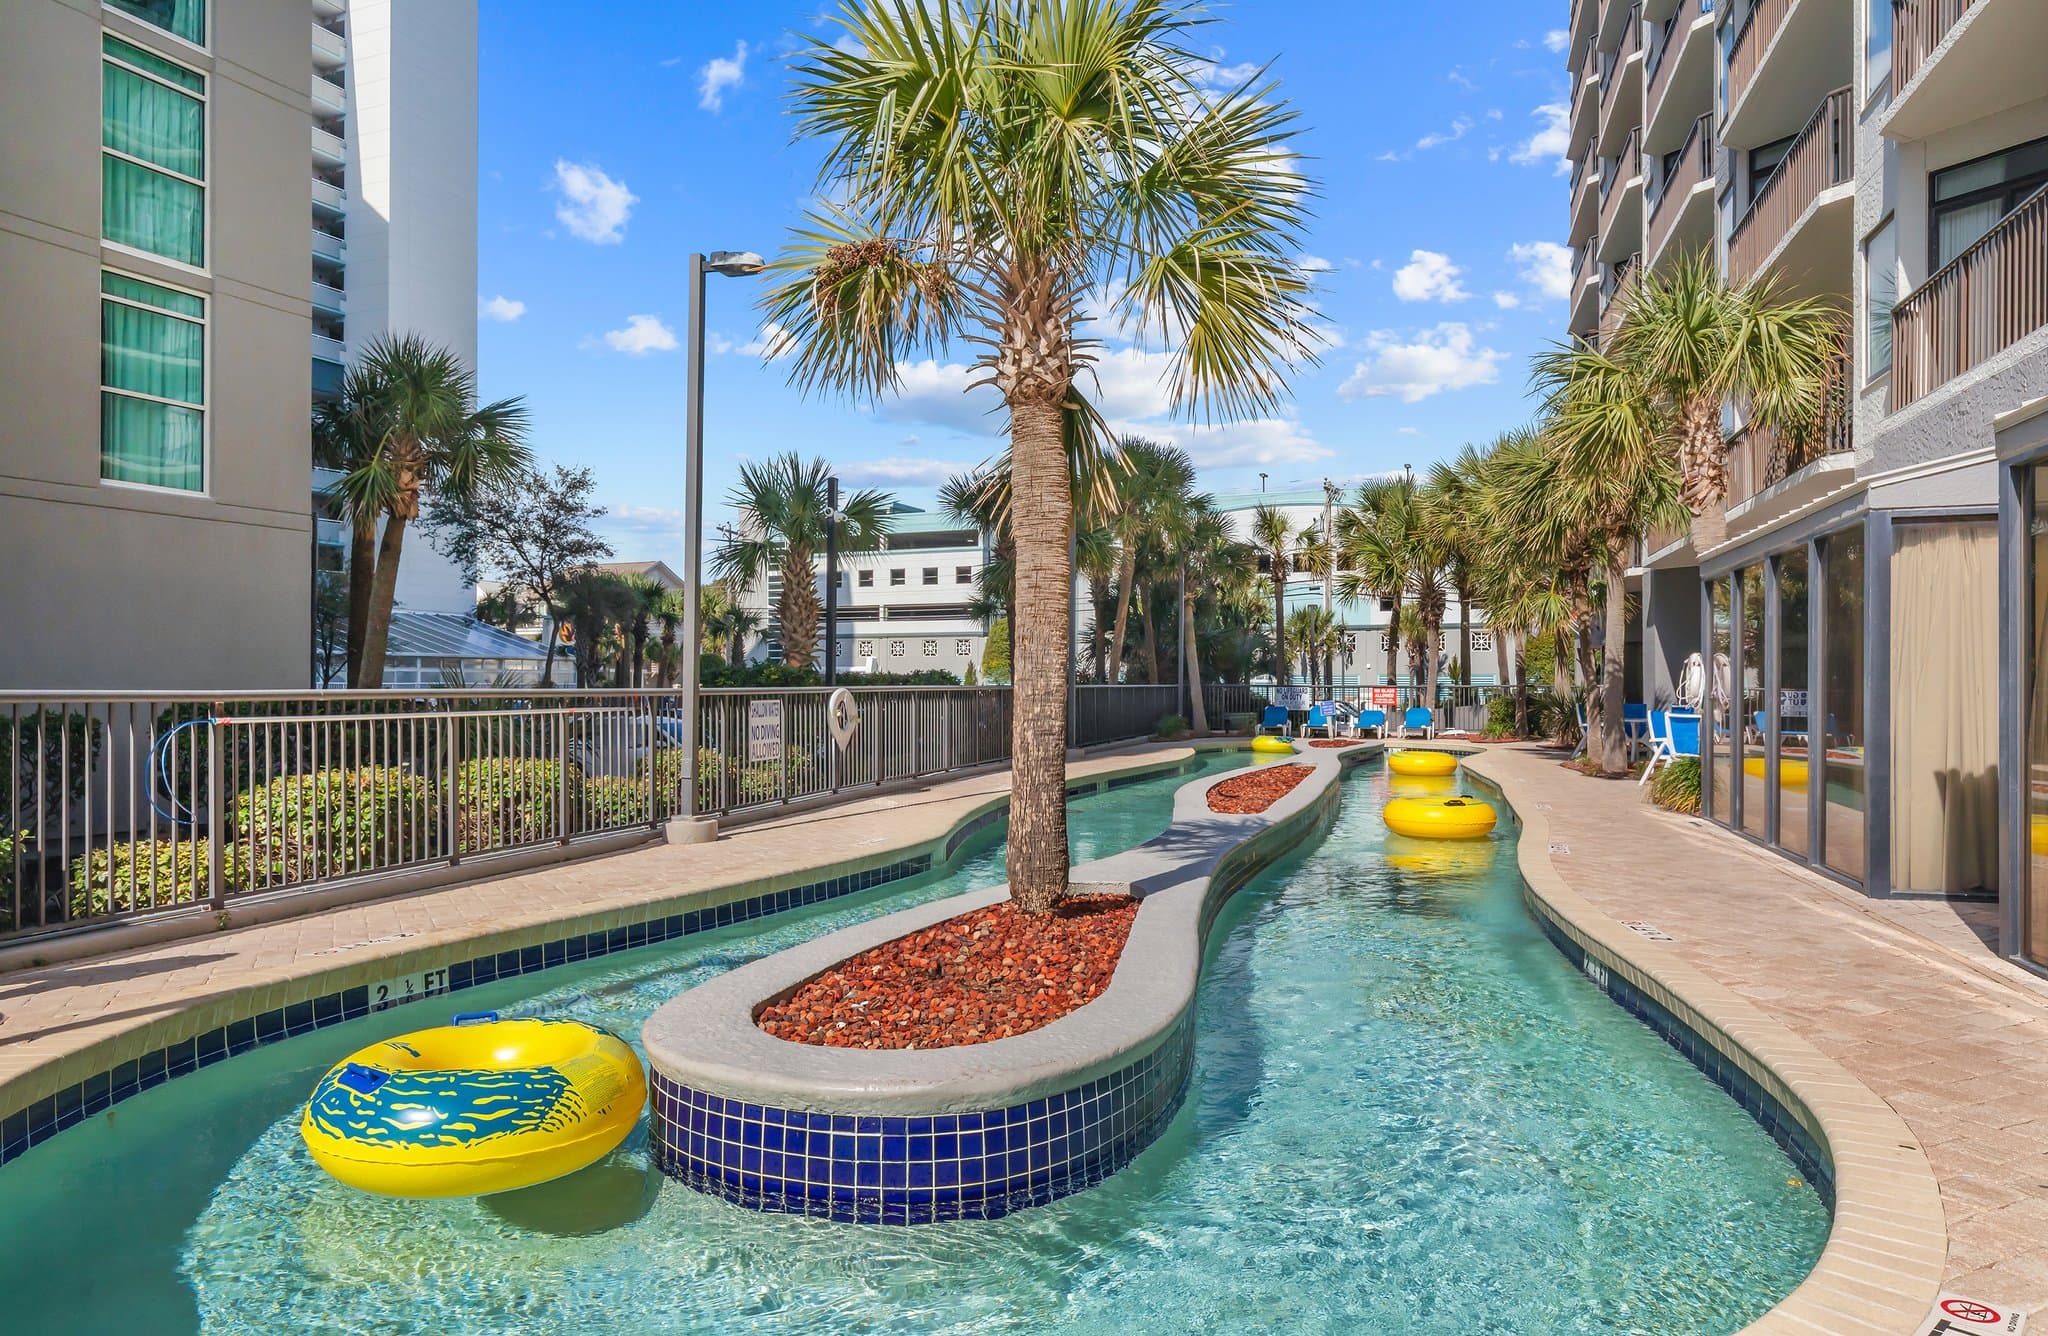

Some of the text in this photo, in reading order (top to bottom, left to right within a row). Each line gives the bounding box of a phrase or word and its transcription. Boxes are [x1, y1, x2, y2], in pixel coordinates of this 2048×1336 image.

[751, 702, 767, 718] SHALLOW
[751, 724, 779, 740] NO DIVING
[751, 742, 779, 758] ALLOWED
[376, 984, 389, 1002] 2
[423, 969, 447, 991] FT
